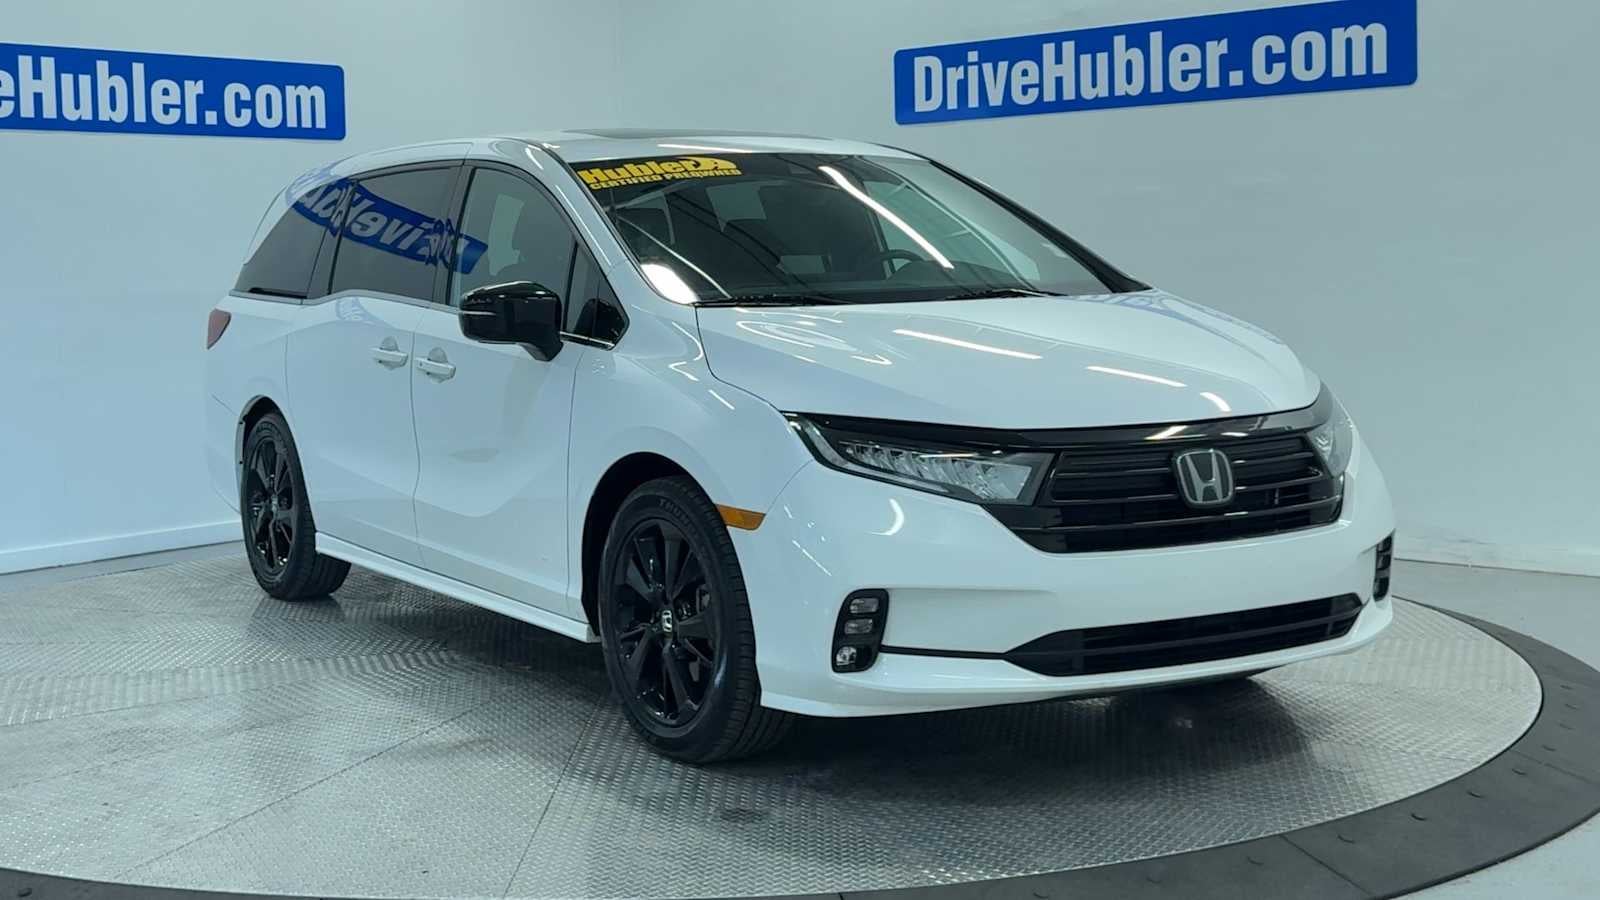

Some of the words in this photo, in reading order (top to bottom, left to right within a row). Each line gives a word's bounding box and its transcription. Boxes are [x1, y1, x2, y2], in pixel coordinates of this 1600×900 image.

[913, 22, 1388, 112] DriveHubler.com
[577, 160, 700, 184] Hubler
[589, 175, 663, 190] CERTIFIED
